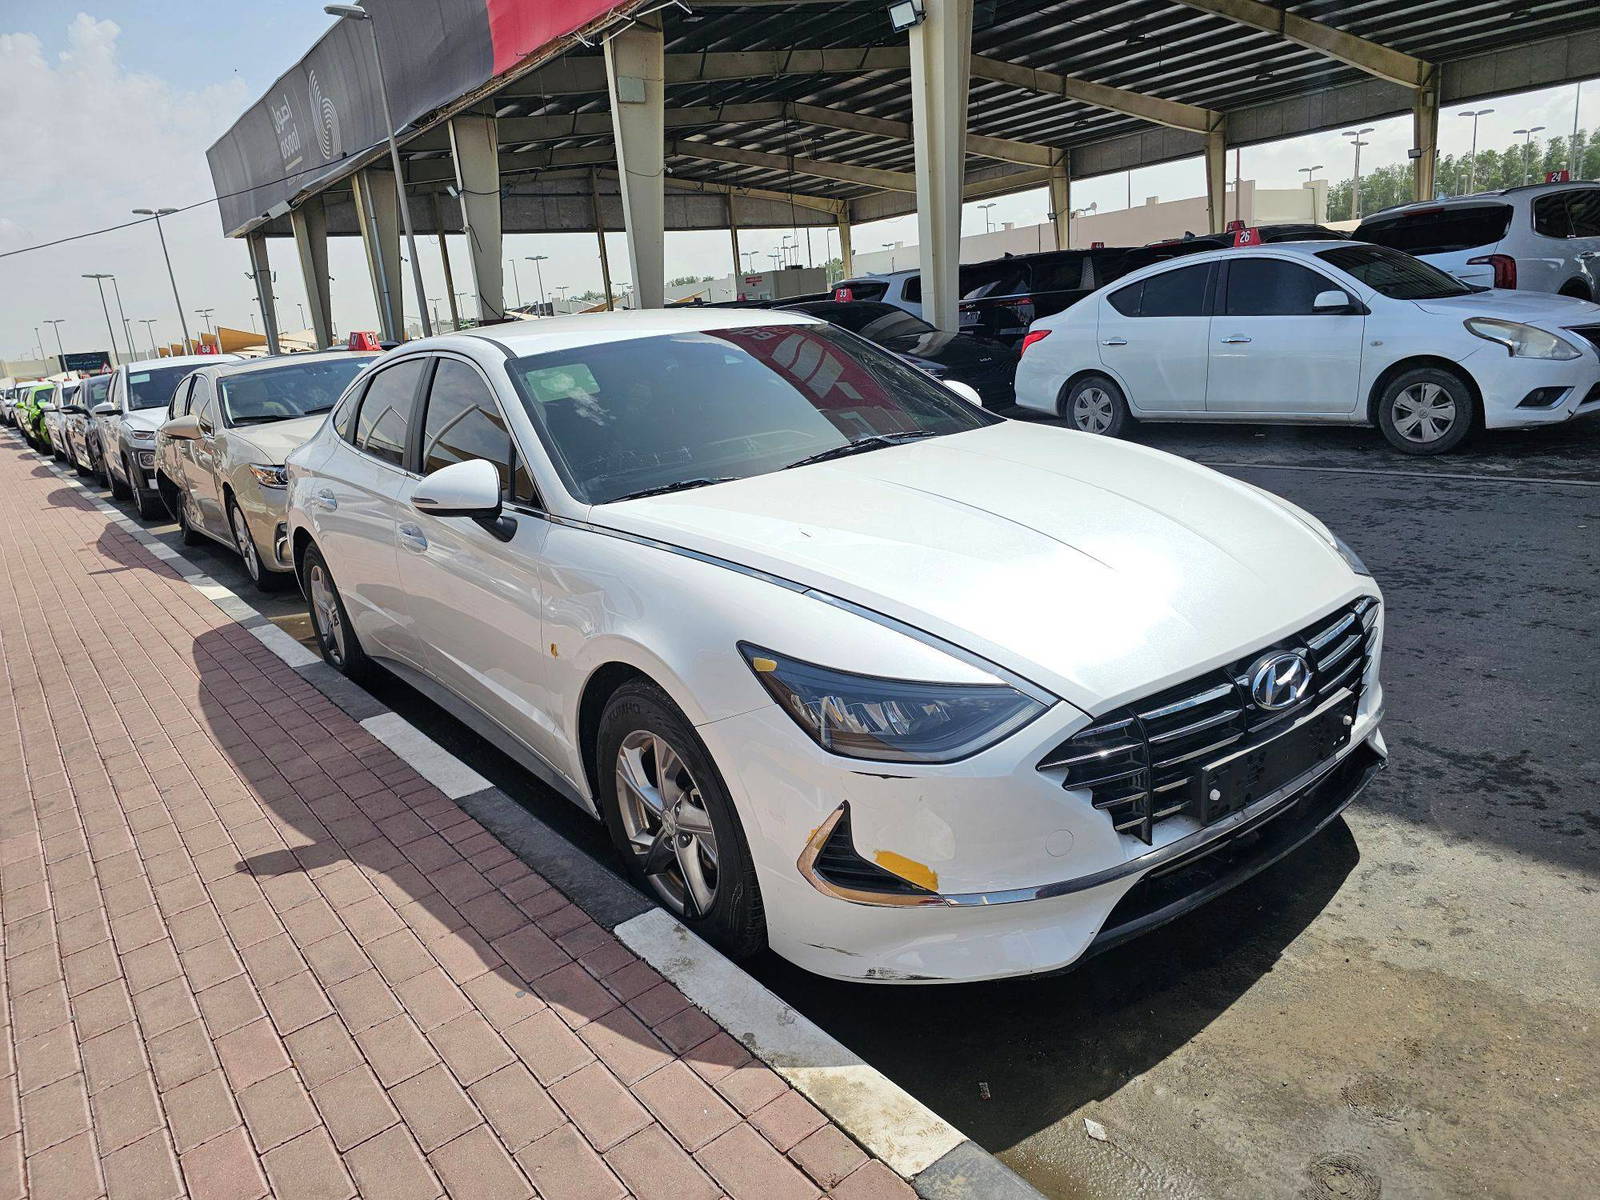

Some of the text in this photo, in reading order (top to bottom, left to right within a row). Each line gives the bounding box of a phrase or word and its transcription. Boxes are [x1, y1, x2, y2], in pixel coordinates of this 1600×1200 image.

[1551, 172, 1561, 182] 24
[1240, 231, 1250, 243] 26
[840, 289, 847, 298] 33
